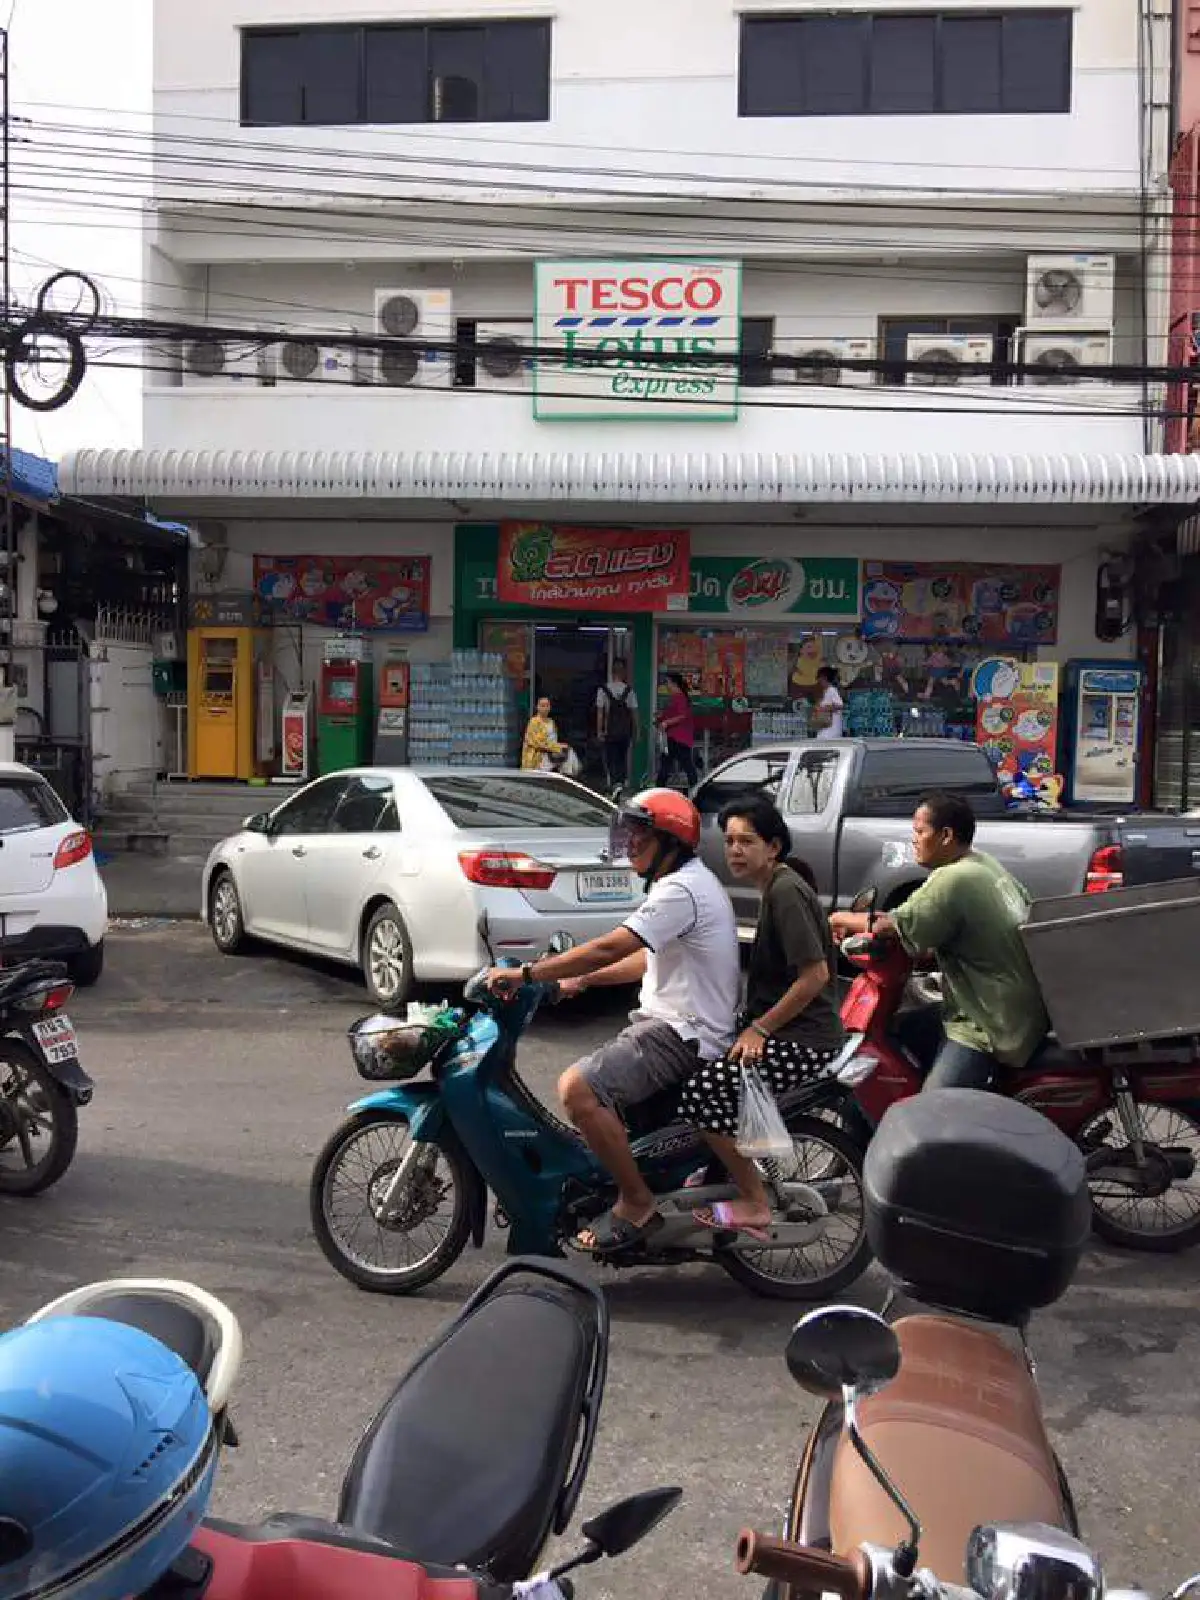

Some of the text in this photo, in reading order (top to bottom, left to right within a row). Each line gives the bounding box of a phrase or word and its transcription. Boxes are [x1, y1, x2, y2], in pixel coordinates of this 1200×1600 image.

[553, 277, 722, 311] TESCO
[562, 329, 717, 370] Lotus
[612, 371, 716, 398] express
